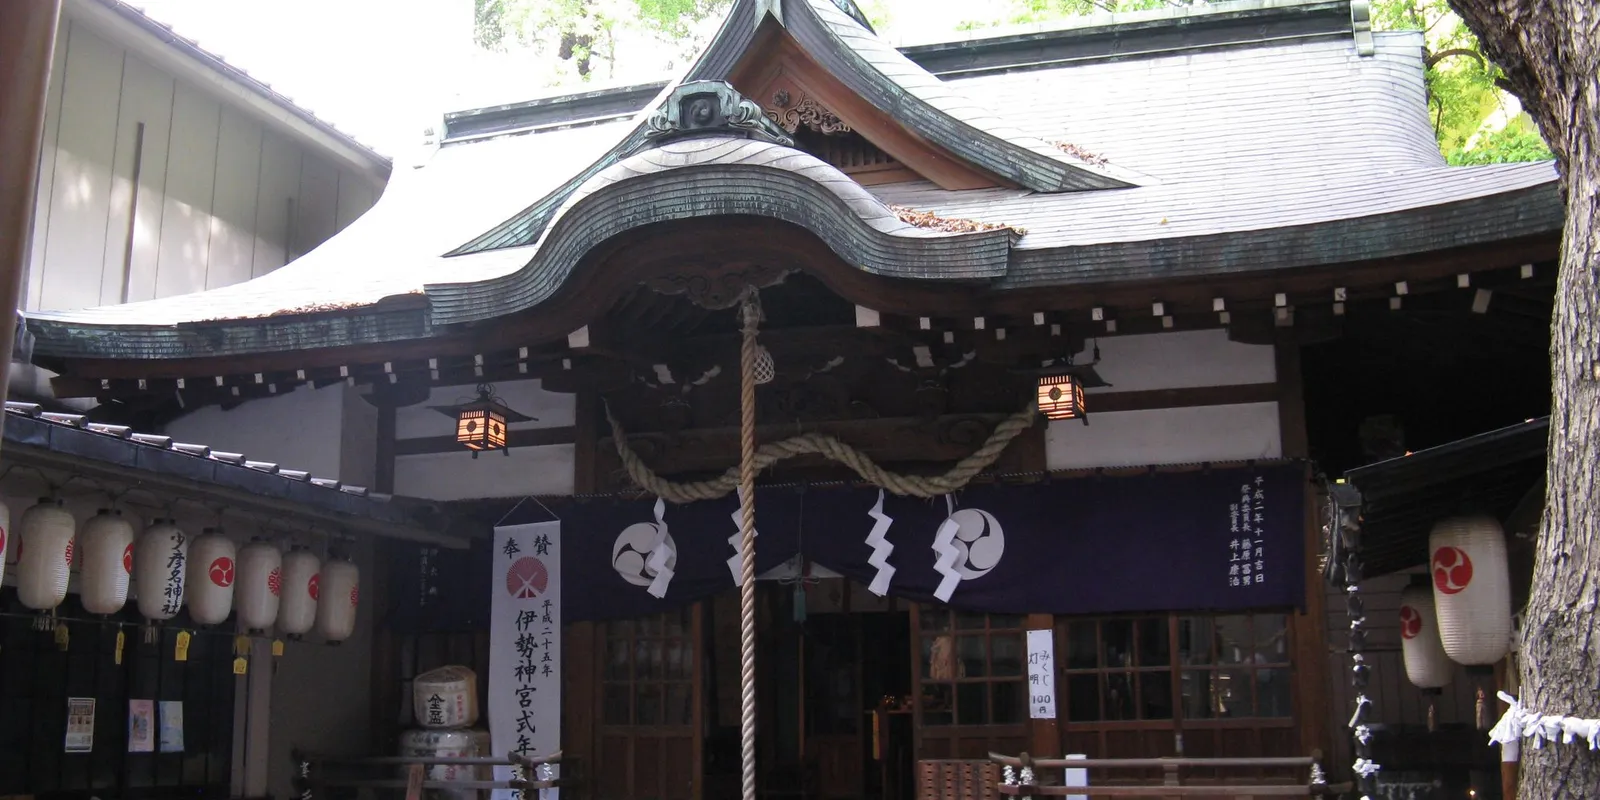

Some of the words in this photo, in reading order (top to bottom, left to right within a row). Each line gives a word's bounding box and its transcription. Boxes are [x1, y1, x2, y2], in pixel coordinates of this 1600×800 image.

[1254, 476, 1264, 583] 平成二年十一月吉日
[161, 532, 185, 615] 少彦名神社
[541, 599, 553, 678] 平成二十五年
[1028, 652, 1040, 685] 灯明
[1039, 649, 1051, 687] みくじ
[511, 610, 538, 800] 伊勢神宮式年
